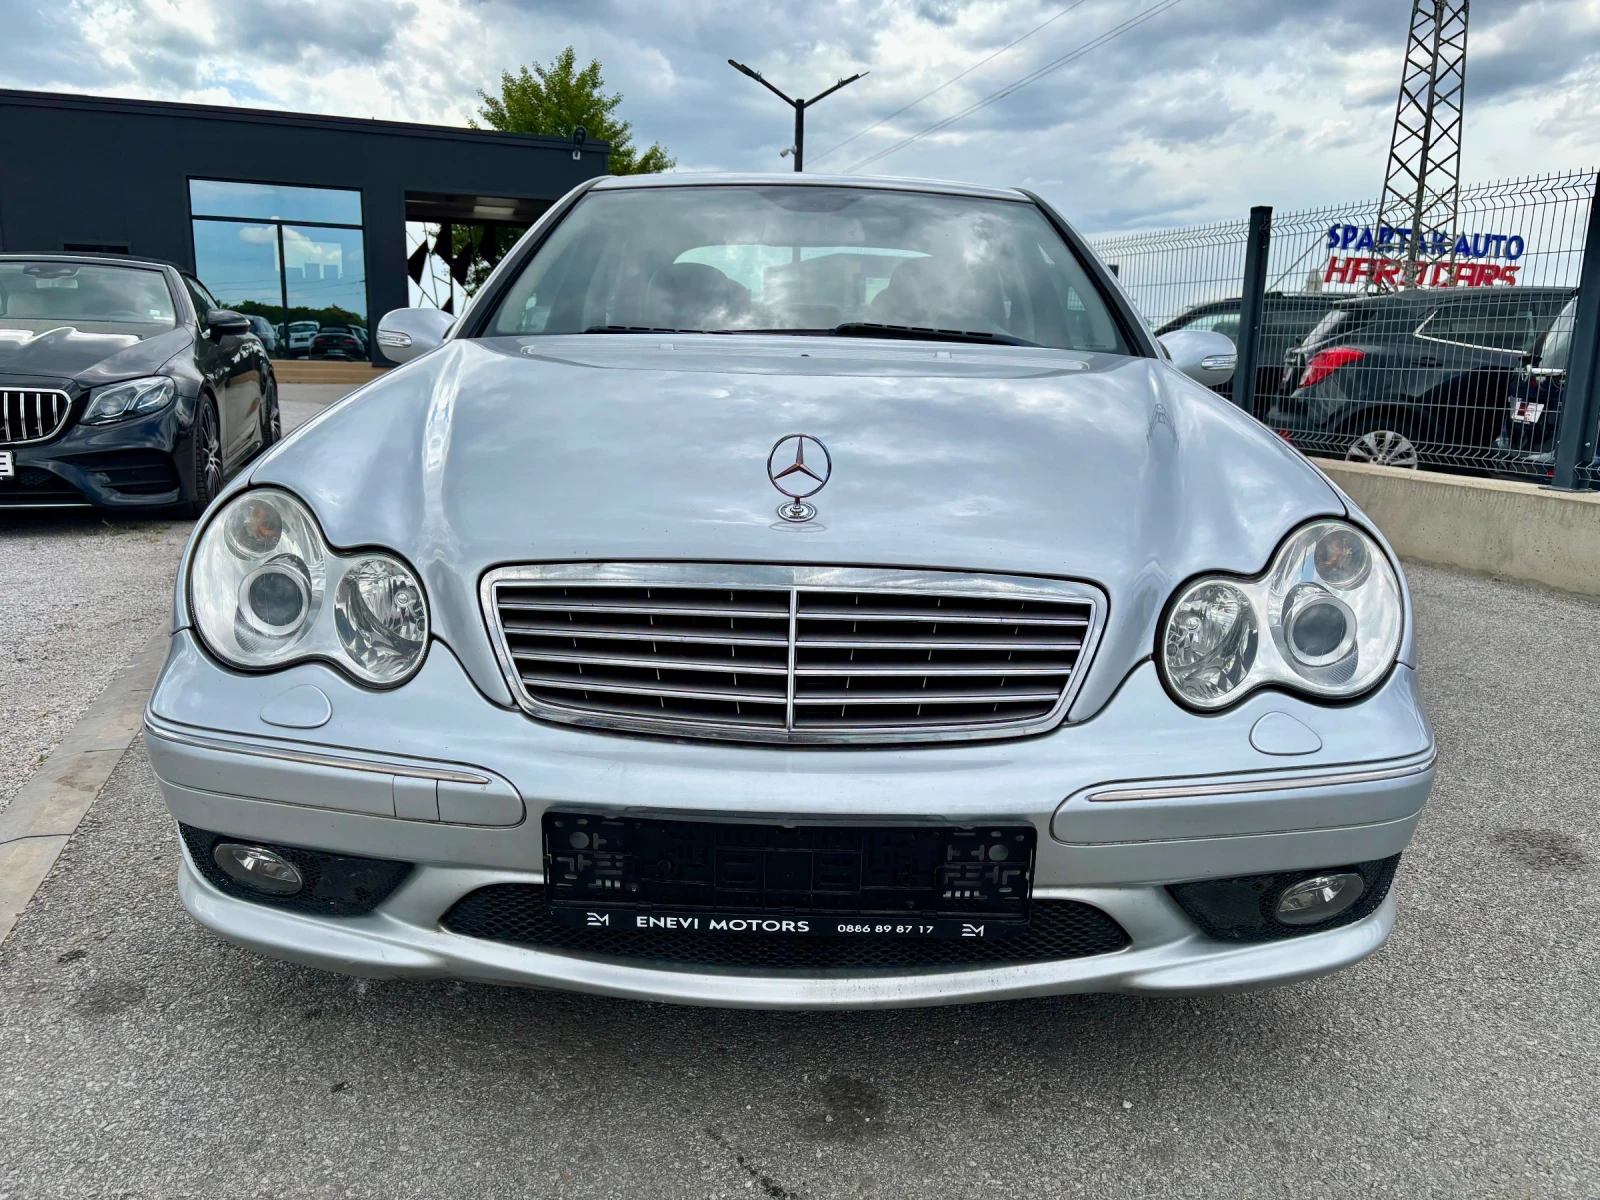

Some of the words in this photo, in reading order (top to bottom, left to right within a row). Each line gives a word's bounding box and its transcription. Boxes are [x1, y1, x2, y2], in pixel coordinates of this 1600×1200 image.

[1328, 223, 1448, 256] SPARTAK
[1454, 231, 1525, 260] AUTO
[1430, 262, 1522, 287] CARS
[636, 916, 699, 930] ENEVI
[708, 918, 810, 932] MOTORS
[837, 924, 871, 933] 0886
[875, 924, 892, 933] 89
[896, 925, 913, 933] 87
[918, 926, 934, 934] 17
